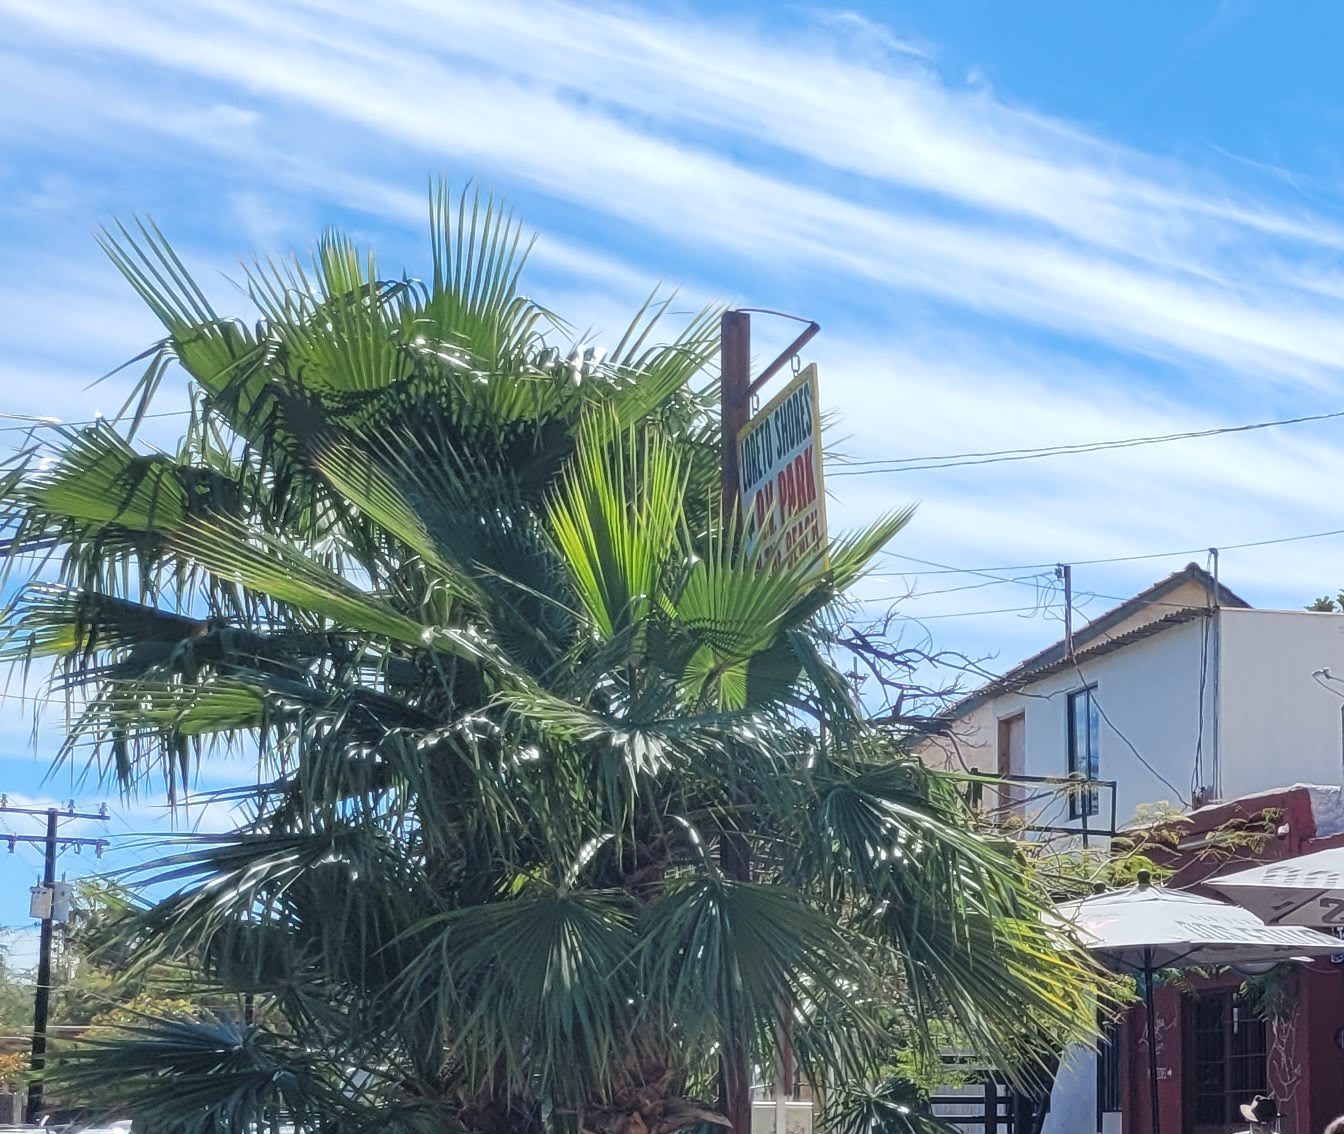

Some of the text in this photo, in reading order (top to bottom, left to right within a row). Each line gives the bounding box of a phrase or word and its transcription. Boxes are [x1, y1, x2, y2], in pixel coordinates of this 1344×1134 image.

[740, 382, 812, 494] LORETO SHORES
[778, 446, 816, 525] PARK
